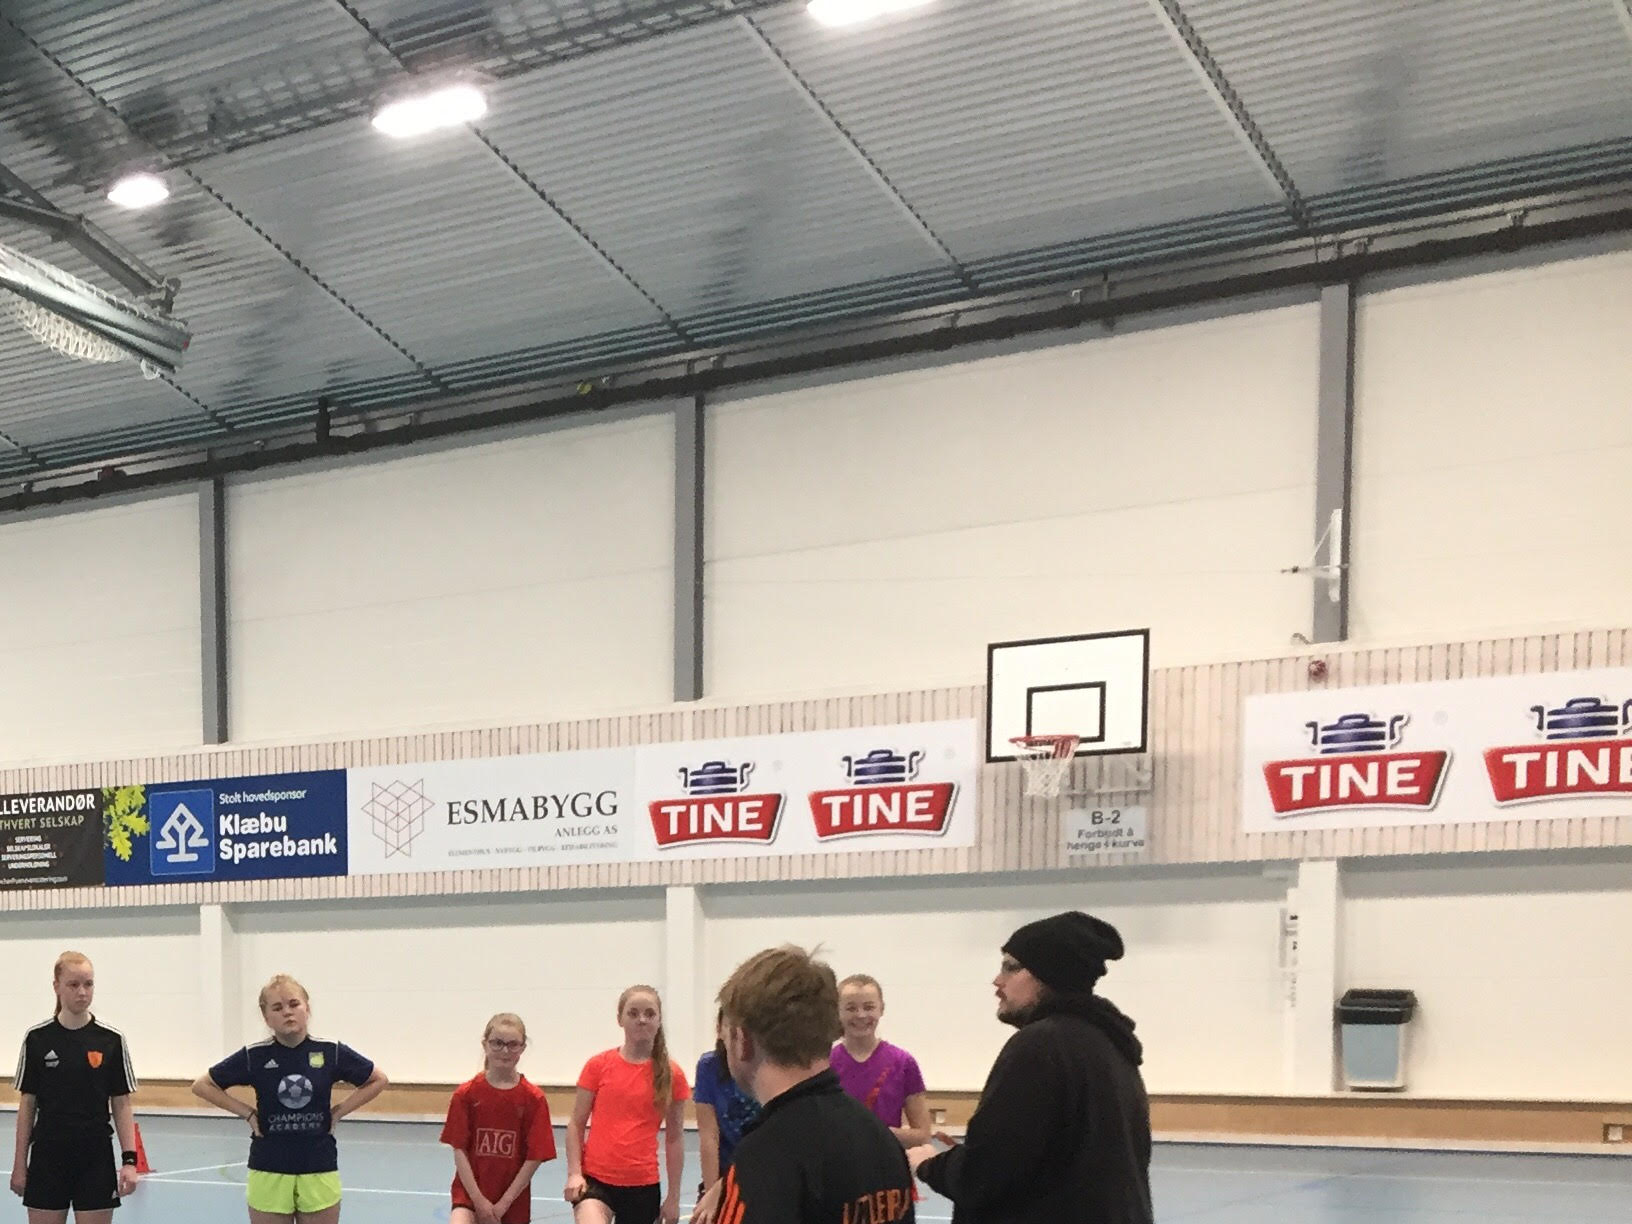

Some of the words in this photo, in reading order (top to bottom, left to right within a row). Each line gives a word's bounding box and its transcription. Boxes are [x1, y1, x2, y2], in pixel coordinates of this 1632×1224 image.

[1280, 757, 1422, 803] TINE
[219, 791, 241, 805] Stolt
[243, 789, 307, 804] hovedsponsor
[447, 790, 618, 826] ESMABYGG
[822, 790, 936, 827] TINE
[40, 815, 85, 829] SELSKAP
[219, 812, 287, 836] Klæbu
[660, 800, 764, 836] TINE
[1091, 809, 1121, 825] B-2
[555, 826, 600, 838] ANLEGG
[603, 825, 618, 836] AS
[219, 832, 338, 865] Sparebank
[478, 1131, 513, 1155] AIG
